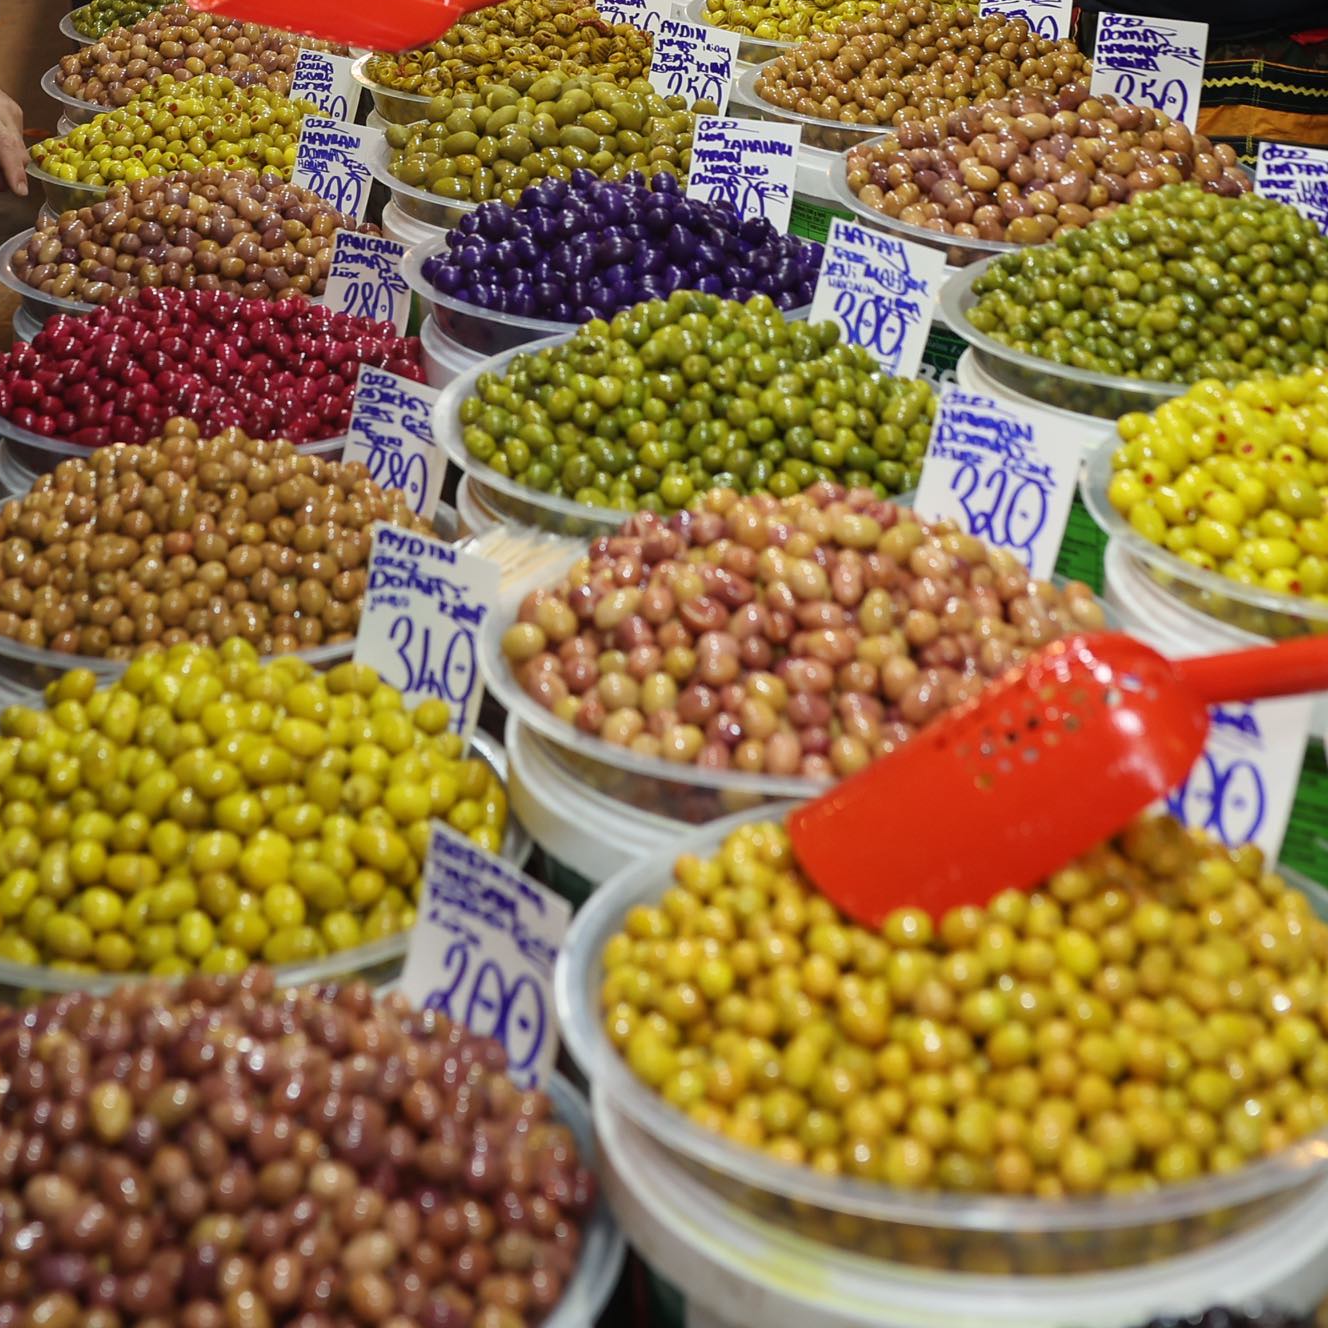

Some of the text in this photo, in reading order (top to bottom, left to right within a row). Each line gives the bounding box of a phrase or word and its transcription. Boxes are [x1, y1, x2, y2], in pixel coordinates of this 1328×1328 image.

[660, 20, 707, 43] AYDIN
[833, 223, 911, 272] HATAY
[377, 528, 457, 565] AYDIN
